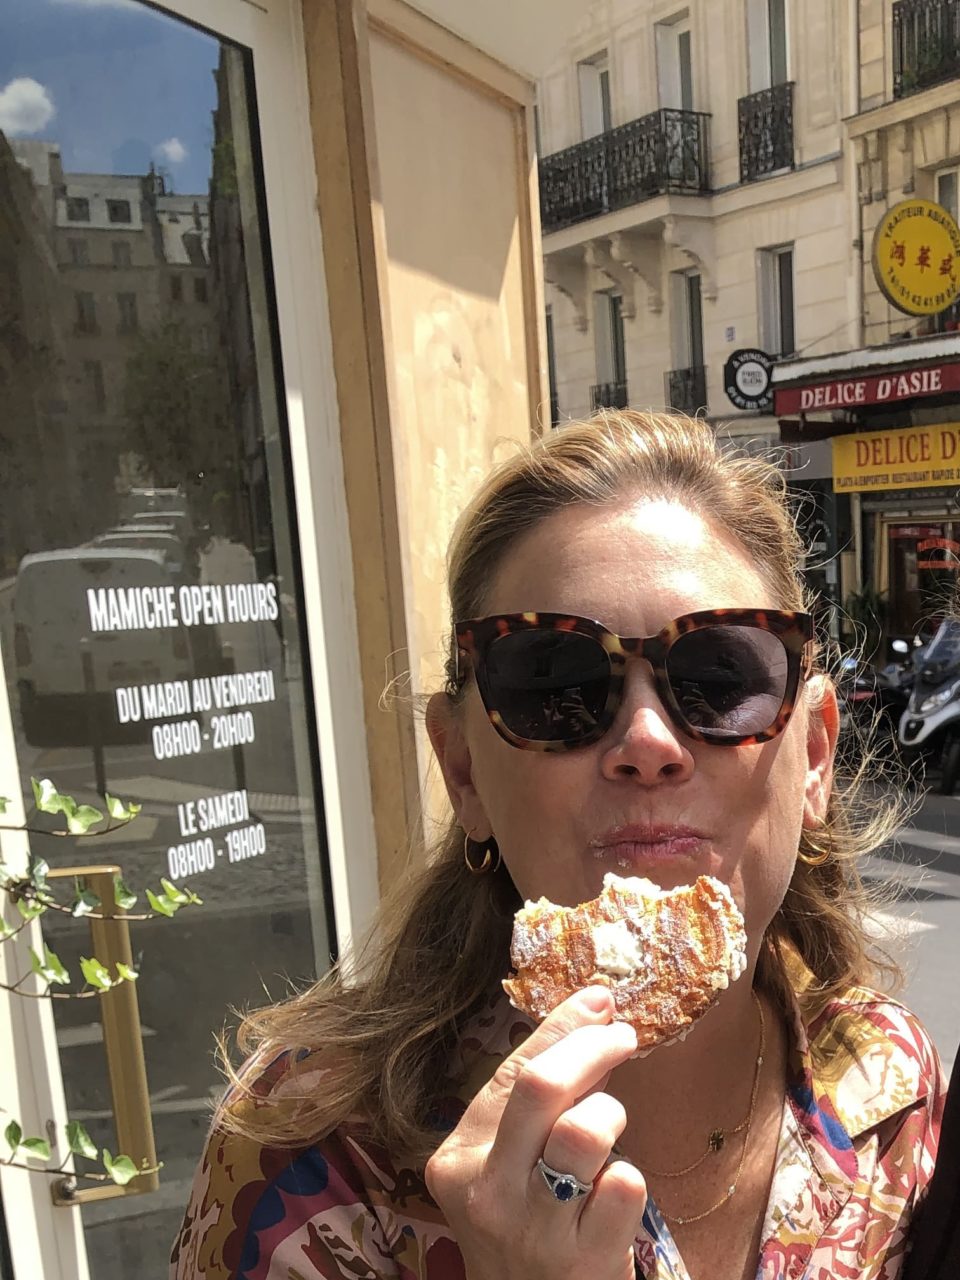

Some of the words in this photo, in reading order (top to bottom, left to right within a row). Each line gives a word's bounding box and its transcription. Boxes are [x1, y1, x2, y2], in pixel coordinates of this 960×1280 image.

[885, 206, 925, 238] TRAITEUR
[800, 382, 867, 409] DELICE
[876, 369, 942, 400] D'ASIE
[855, 433, 931, 467] DELICE
[892, 470, 930, 484] RESTAURANT
[931, 468, 955, 480] RAPIDE
[87, 586, 179, 632] MAMICHE
[179, 584, 223, 626] OPEN
[225, 582, 279, 623] HOURS
[116, 686, 141, 723] DU
[141, 680, 191, 719] MARDI
[192, 677, 212, 713] AU
[211, 670, 276, 711] VENDREDI
[152, 719, 201, 760] 08H00
[212, 711, 255, 749] 20H00
[178, 802, 198, 837] LE
[198, 789, 250, 832] SAMEDI
[167, 837, 216, 880] 08H00
[224, 823, 267, 863] 19H00
